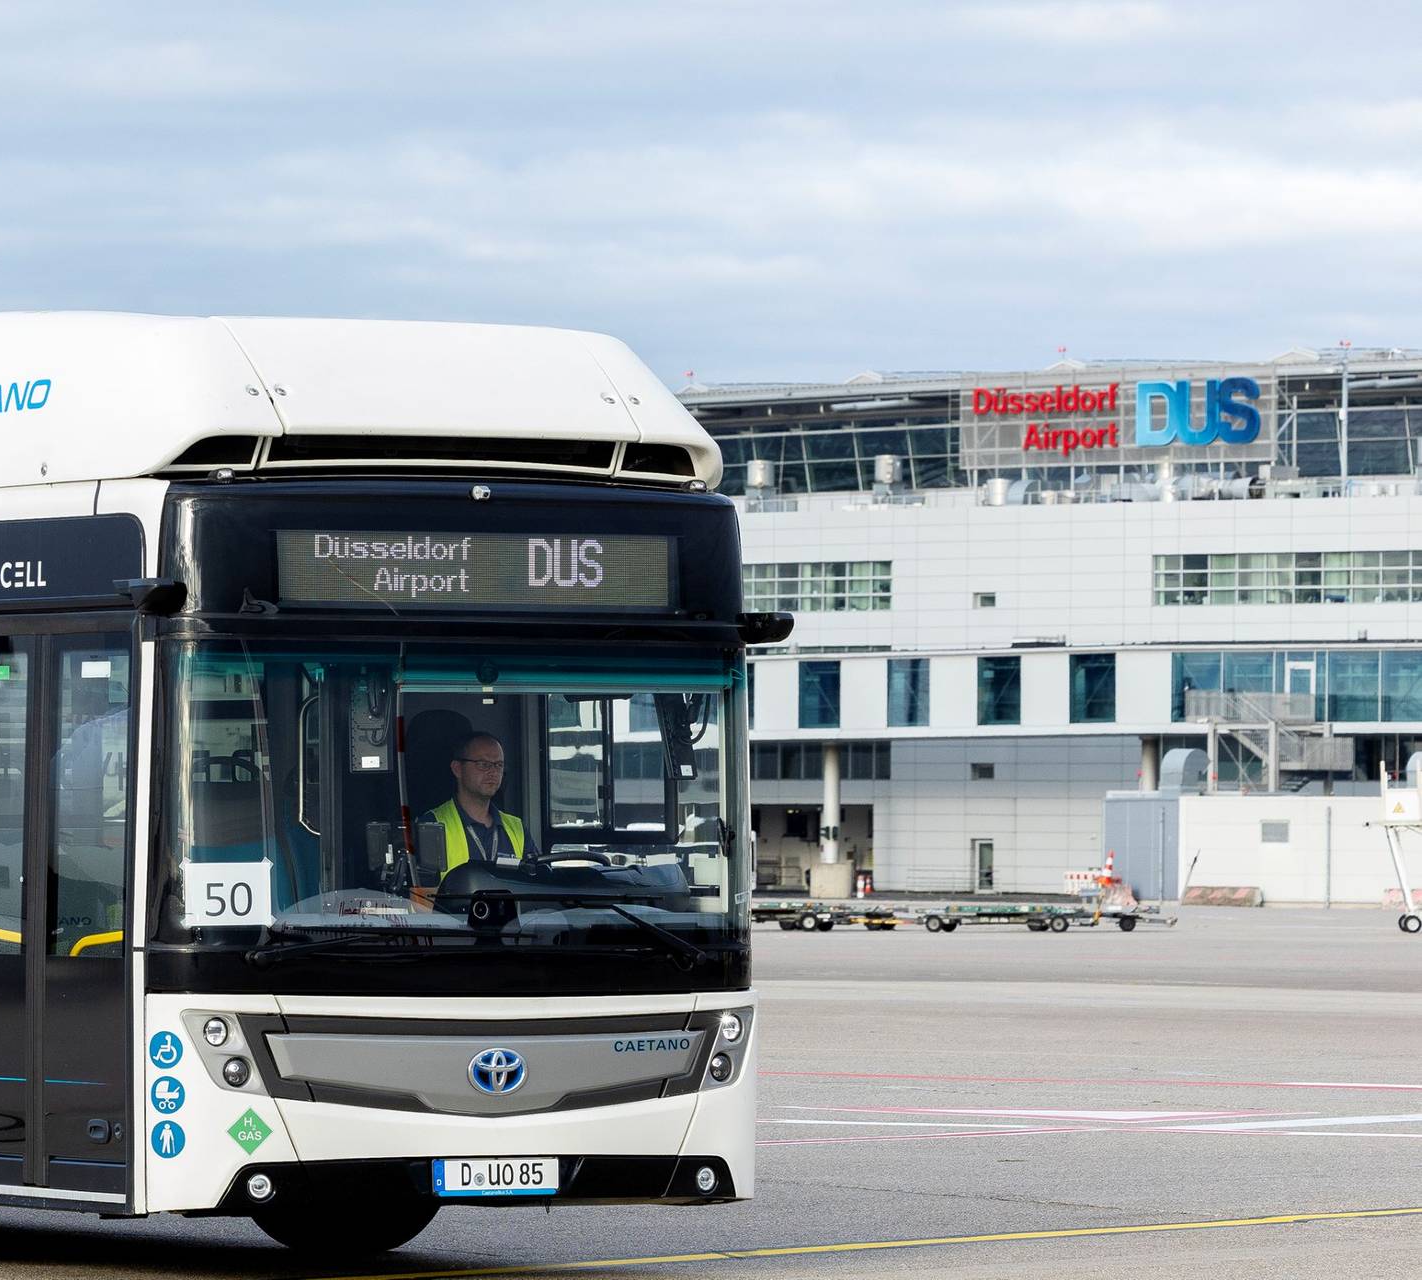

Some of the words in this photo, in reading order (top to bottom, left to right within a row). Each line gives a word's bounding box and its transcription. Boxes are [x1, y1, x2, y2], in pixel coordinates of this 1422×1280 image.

[973, 382, 1119, 415] Düsseldorf
[1136, 377, 1262, 447] DUS
[1023, 422, 1119, 457] Airport
[314, 534, 471, 560] Düsseldorf
[528, 538, 603, 588] DUS
[374, 567, 470, 598] Airport
[205, 881, 253, 917] 50
[614, 1038, 690, 1052] CAETANO
[238, 1130, 262, 1141] GAS
[461, 1163, 472, 1186] D
[519, 1162, 544, 1186] 85
